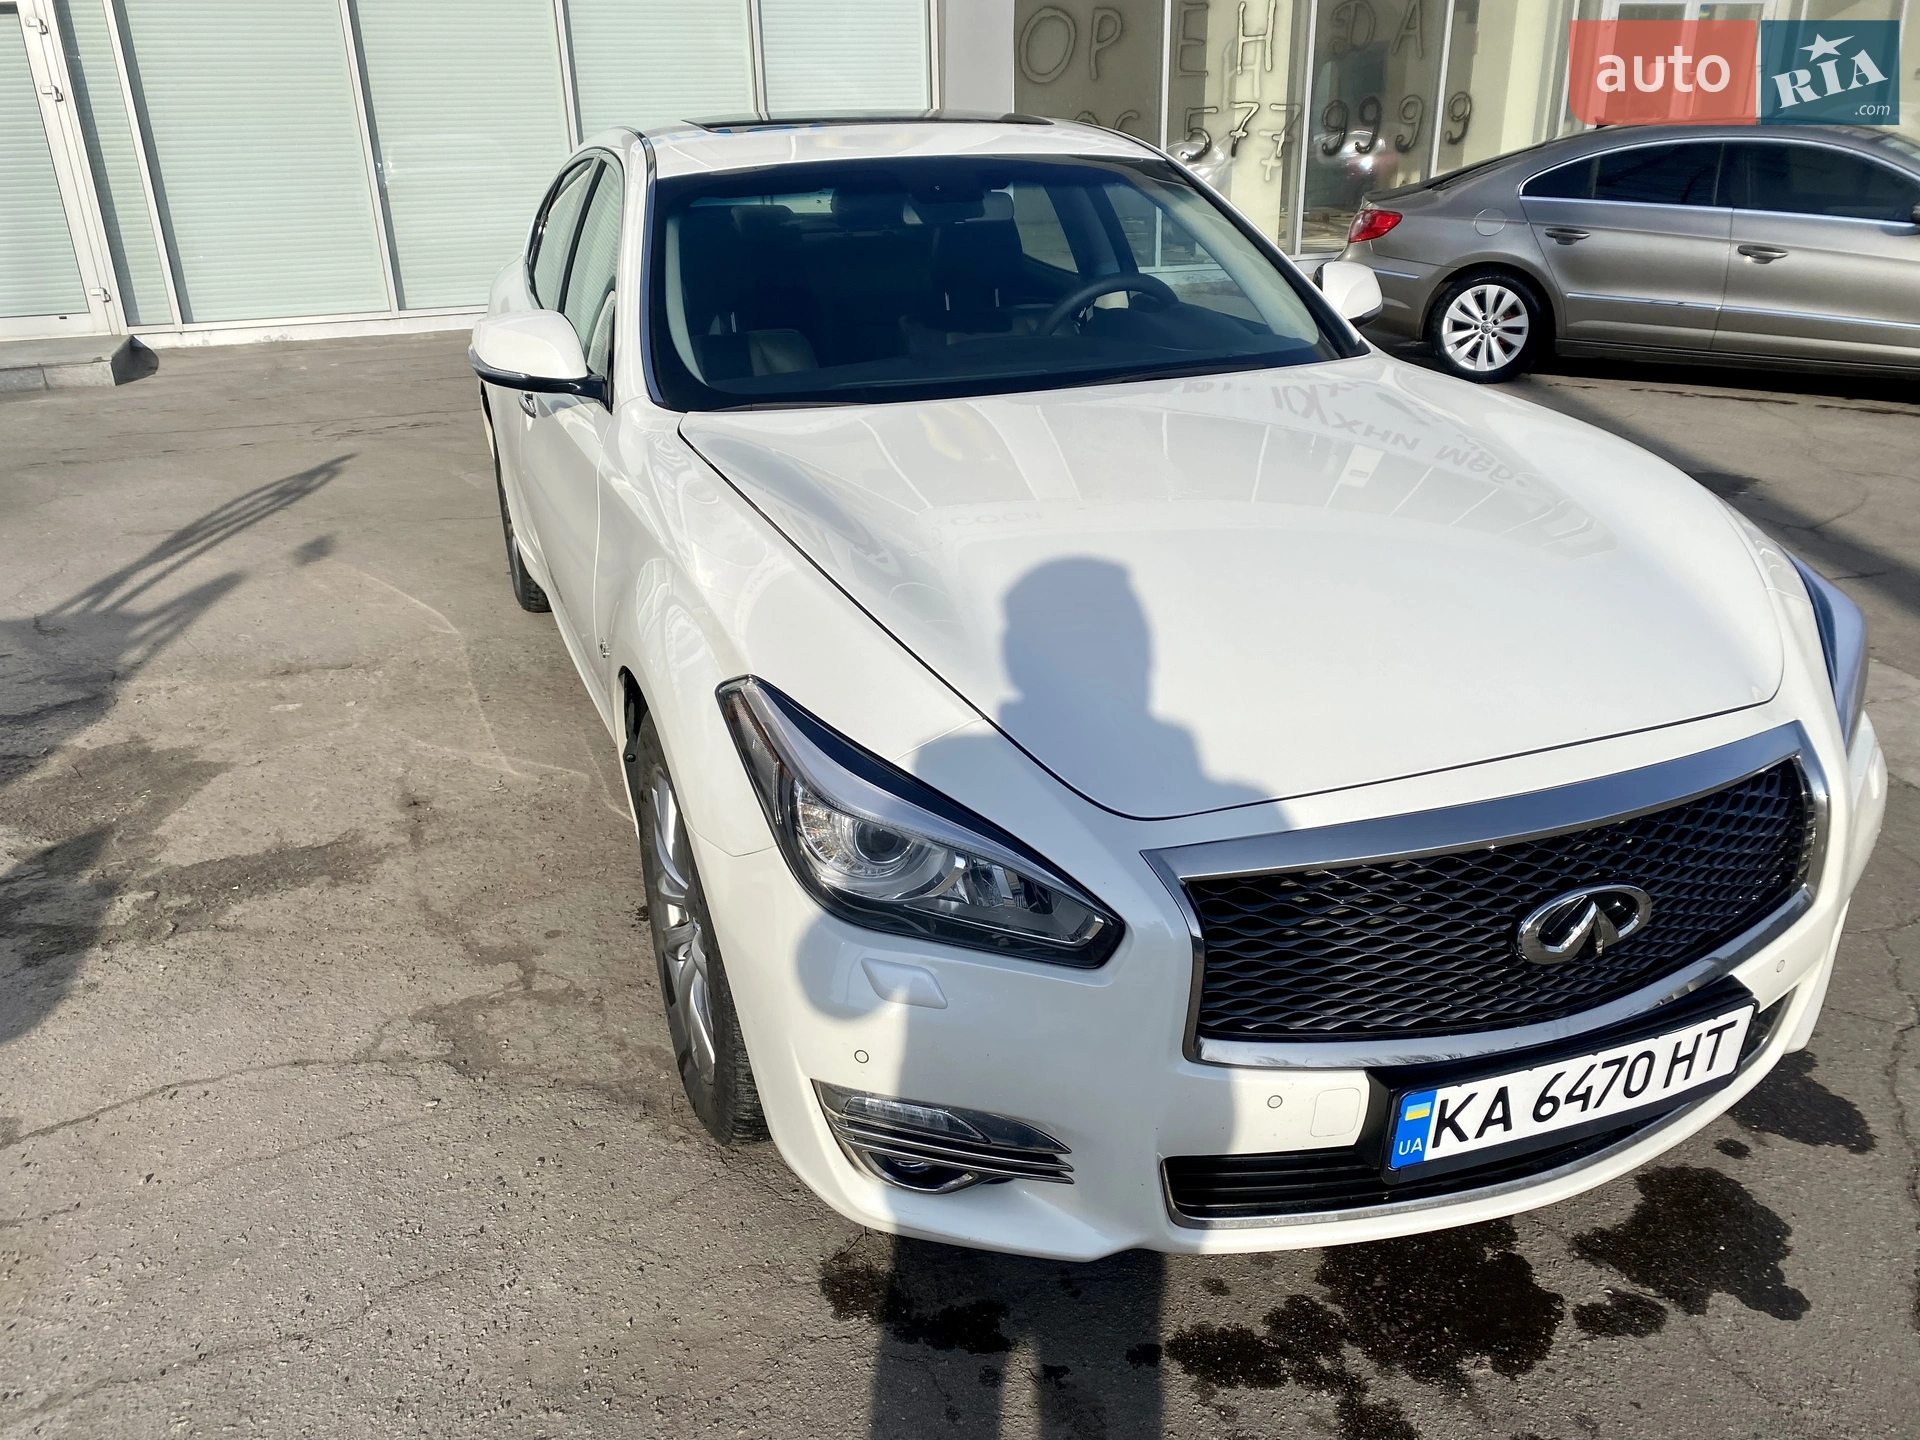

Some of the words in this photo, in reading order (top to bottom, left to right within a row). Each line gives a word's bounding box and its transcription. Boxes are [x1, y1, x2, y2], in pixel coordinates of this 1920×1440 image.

[1431, 1086, 1513, 1148] KA
[1532, 1050, 1656, 1123] 6470
[1663, 1020, 1737, 1088] HT
[1398, 1137, 1423, 1156] UA
